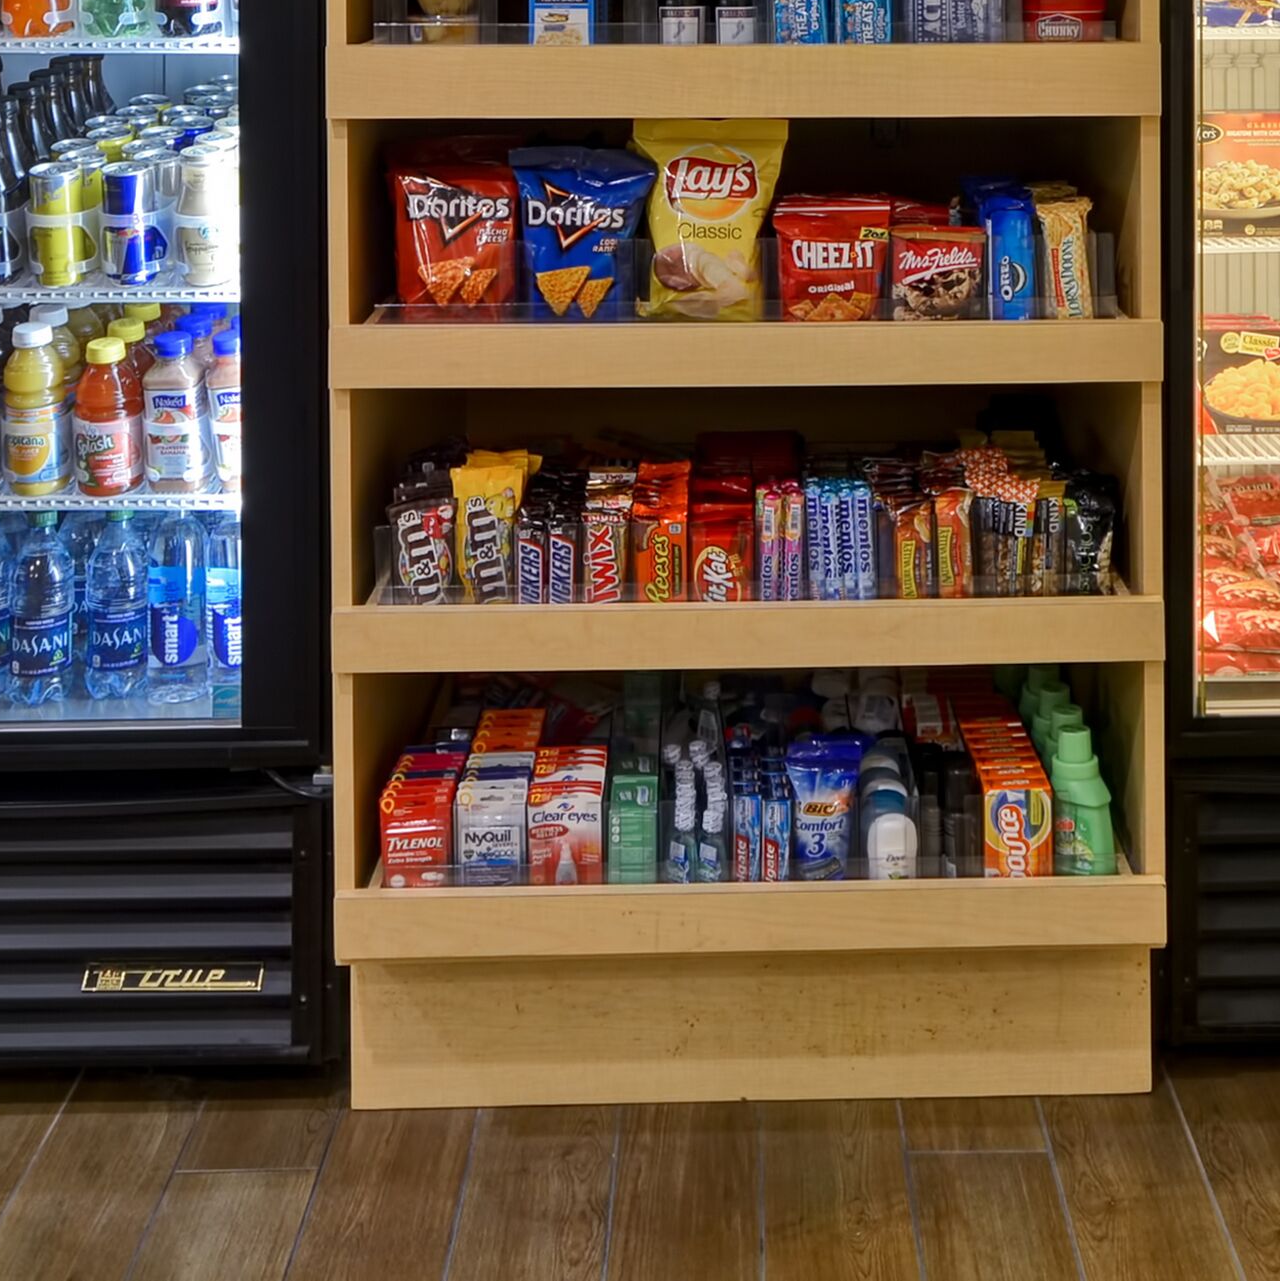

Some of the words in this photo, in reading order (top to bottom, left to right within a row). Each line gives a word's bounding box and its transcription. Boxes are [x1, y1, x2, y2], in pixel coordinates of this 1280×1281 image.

[1037, 23, 1081, 38] CHUNKY
[670, 161, 752, 200] Lay's
[410, 193, 510, 220] Doritos
[527, 200, 625, 229] Doritos
[677, 222, 743, 240] Classic
[1000, 255, 1013, 301] OREO
[1243, 335, 1277, 347] Classic
[156, 395, 184, 407] Naked
[1013, 502, 1026, 537] KIND
[1048, 497, 1060, 534] KIND
[808, 497, 821, 571] mentos
[840, 500, 854, 574] mentos
[858, 499, 871, 573] mentos
[644, 534, 669, 604] Reese's
[12, 631, 68, 656] DASANI
[93, 624, 146, 648] DASANI
[164, 614, 179, 664] smart
[532, 811, 565, 823] Clear
[568, 811, 598, 822] eyes
[805, 803, 837, 815] BIC
[794, 819, 844, 832] Comfort
[387, 837, 443, 851] TYLENOL
[465, 830, 511, 848] NyQuil
[808, 832, 825, 857] 3
[405, 855, 432, 864] Strength
[886, 853, 907, 863] Dove
